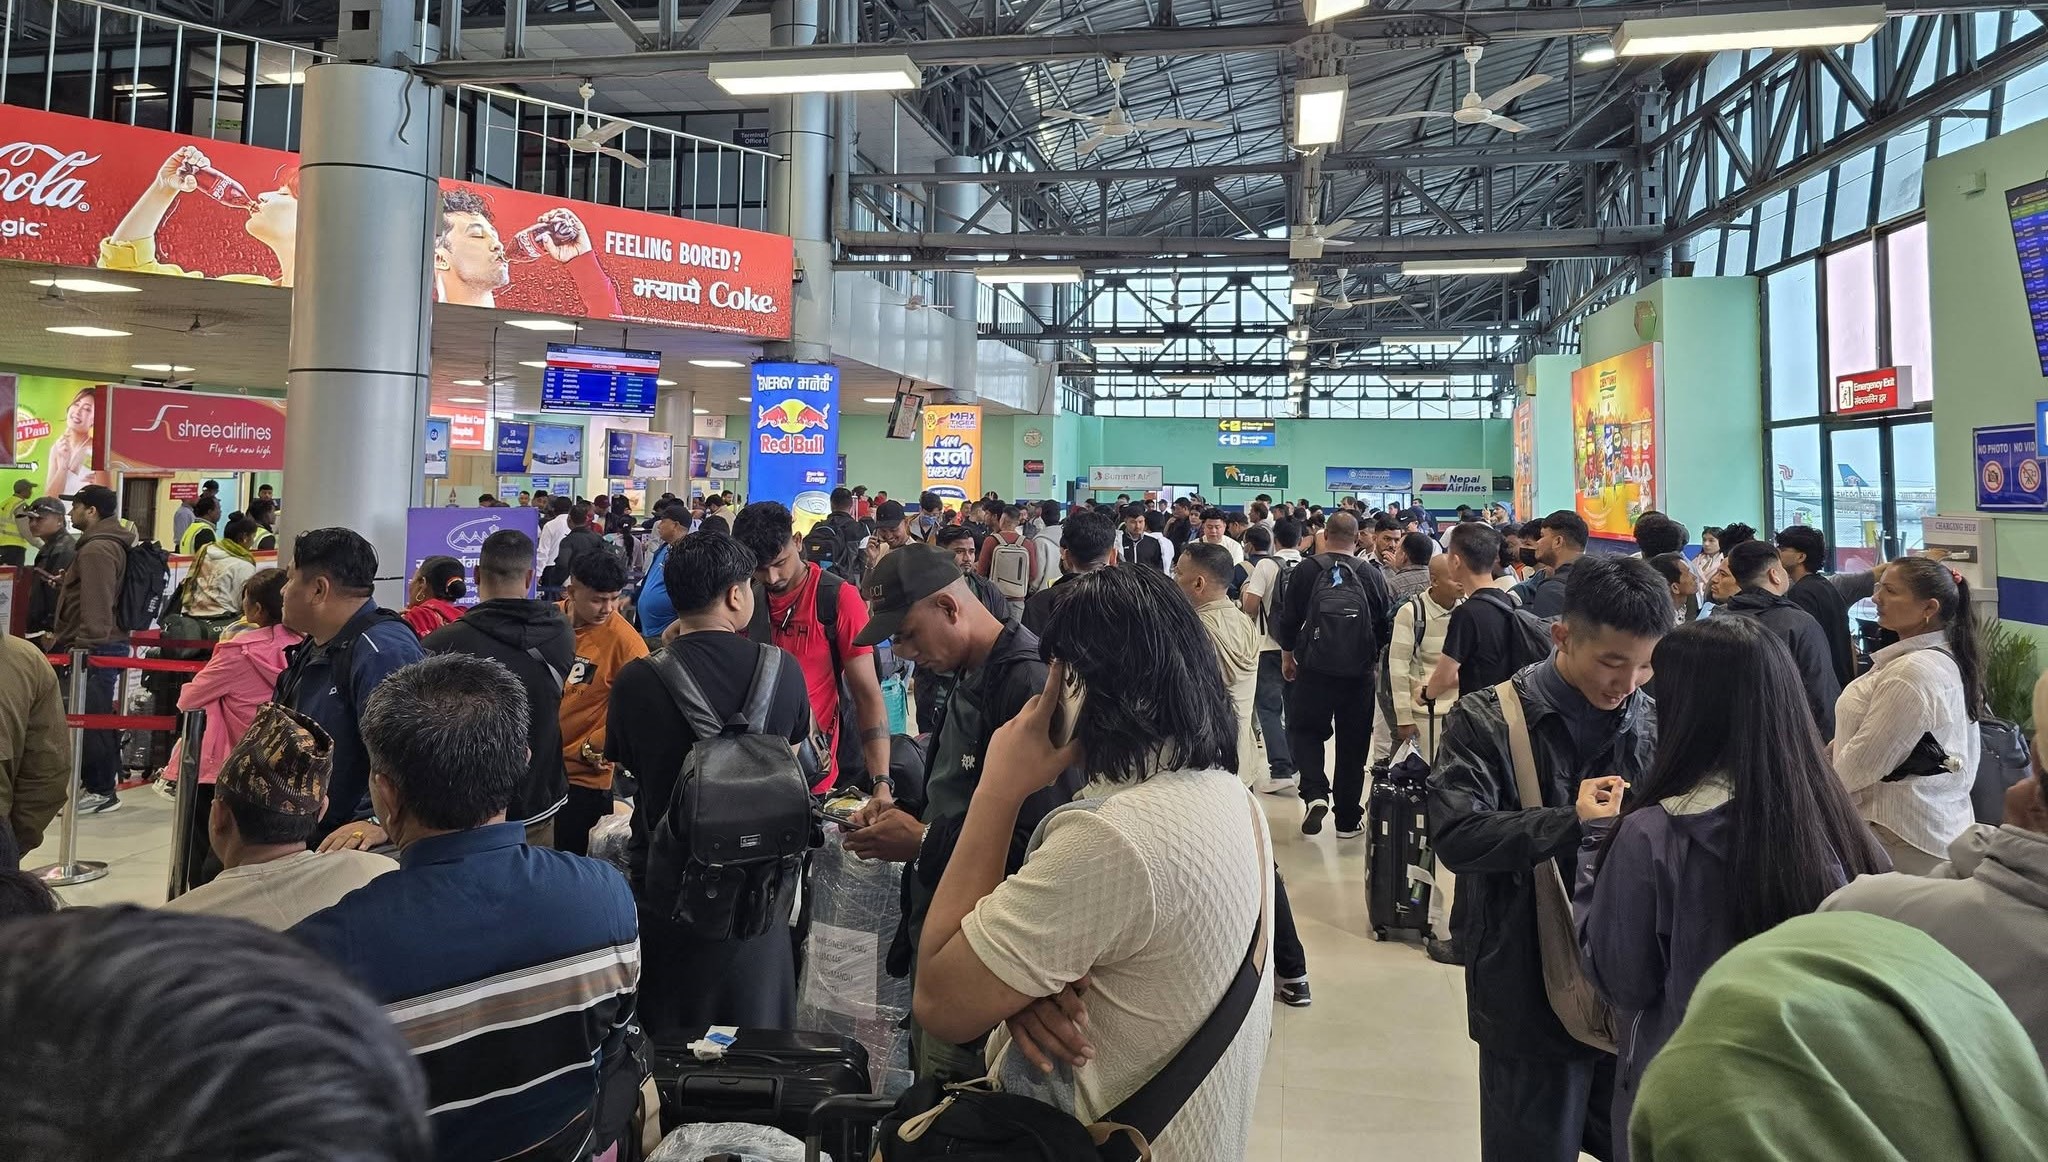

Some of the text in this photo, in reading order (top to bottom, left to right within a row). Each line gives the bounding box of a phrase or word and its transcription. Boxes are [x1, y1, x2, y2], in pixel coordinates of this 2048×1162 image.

[0, 217, 40, 238] gic
[605, 230, 672, 263] FEELING
[709, 281, 774, 314] Coke
[1853, 376, 1895, 392] Emergency Exit
[950, 412, 975, 420] MAX
[24, 424, 50, 438] Pani
[760, 434, 825, 454] Red Bull
[941, 435, 961, 448] AM
[1978, 444, 1987, 454] NO
[1987, 443, 2009, 454] PHOTO
[2013, 442, 2023, 453] NO
[208, 443, 271, 459] Fly the new high
[1239, 473, 1277, 483] Tara Air
[1449, 474, 1481, 485] Nepal
[1446, 483, 1487, 493] Airlines
[1934, 521, 1977, 532] CHARGING HUB
